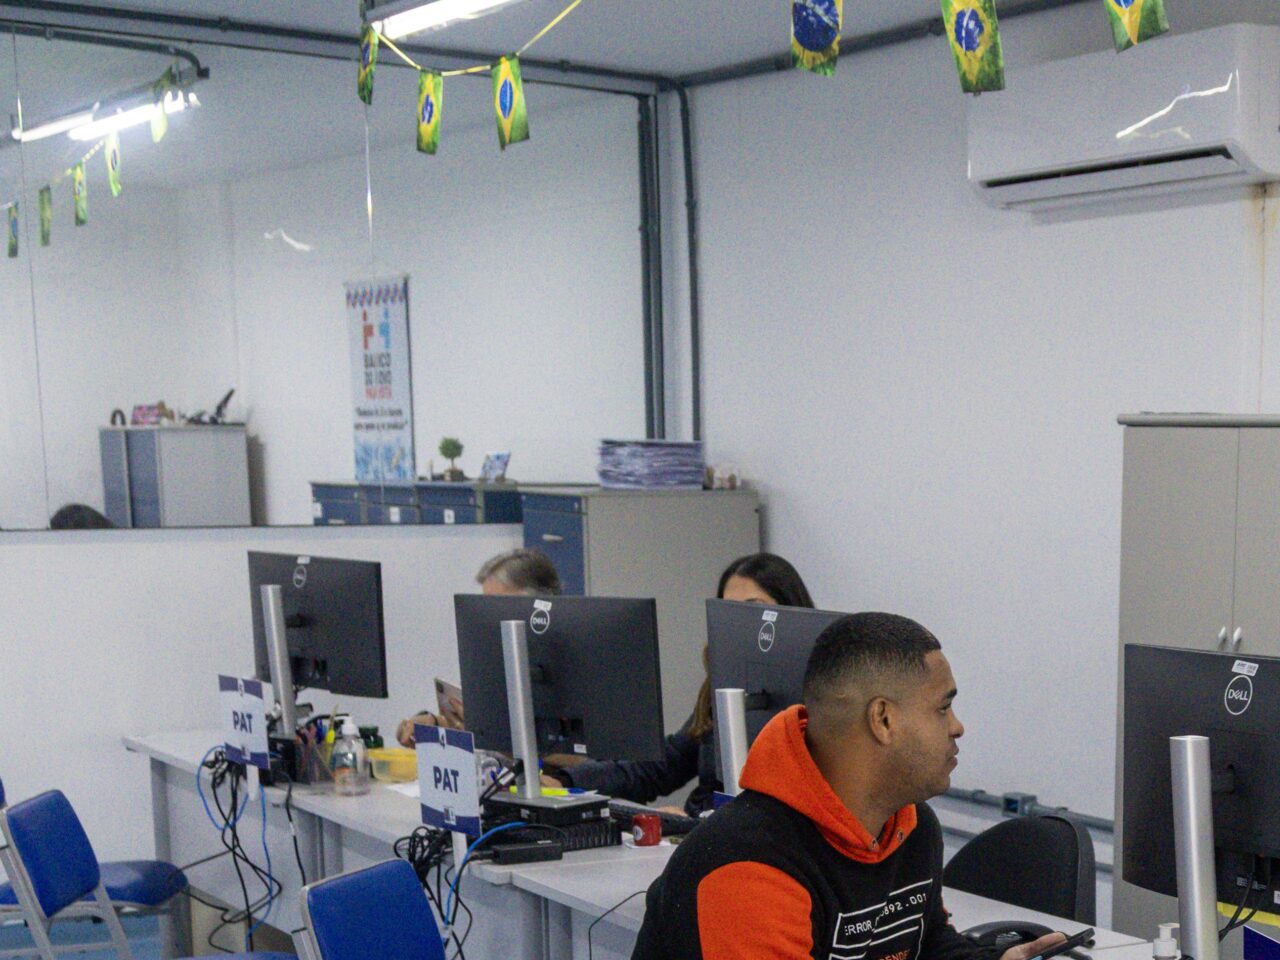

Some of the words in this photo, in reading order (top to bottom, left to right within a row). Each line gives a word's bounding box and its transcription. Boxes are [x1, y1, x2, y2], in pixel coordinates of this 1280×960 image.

[1228, 688, 1249, 701] DELL
[232, 710, 253, 734] PAT
[433, 766, 460, 794] PAT
